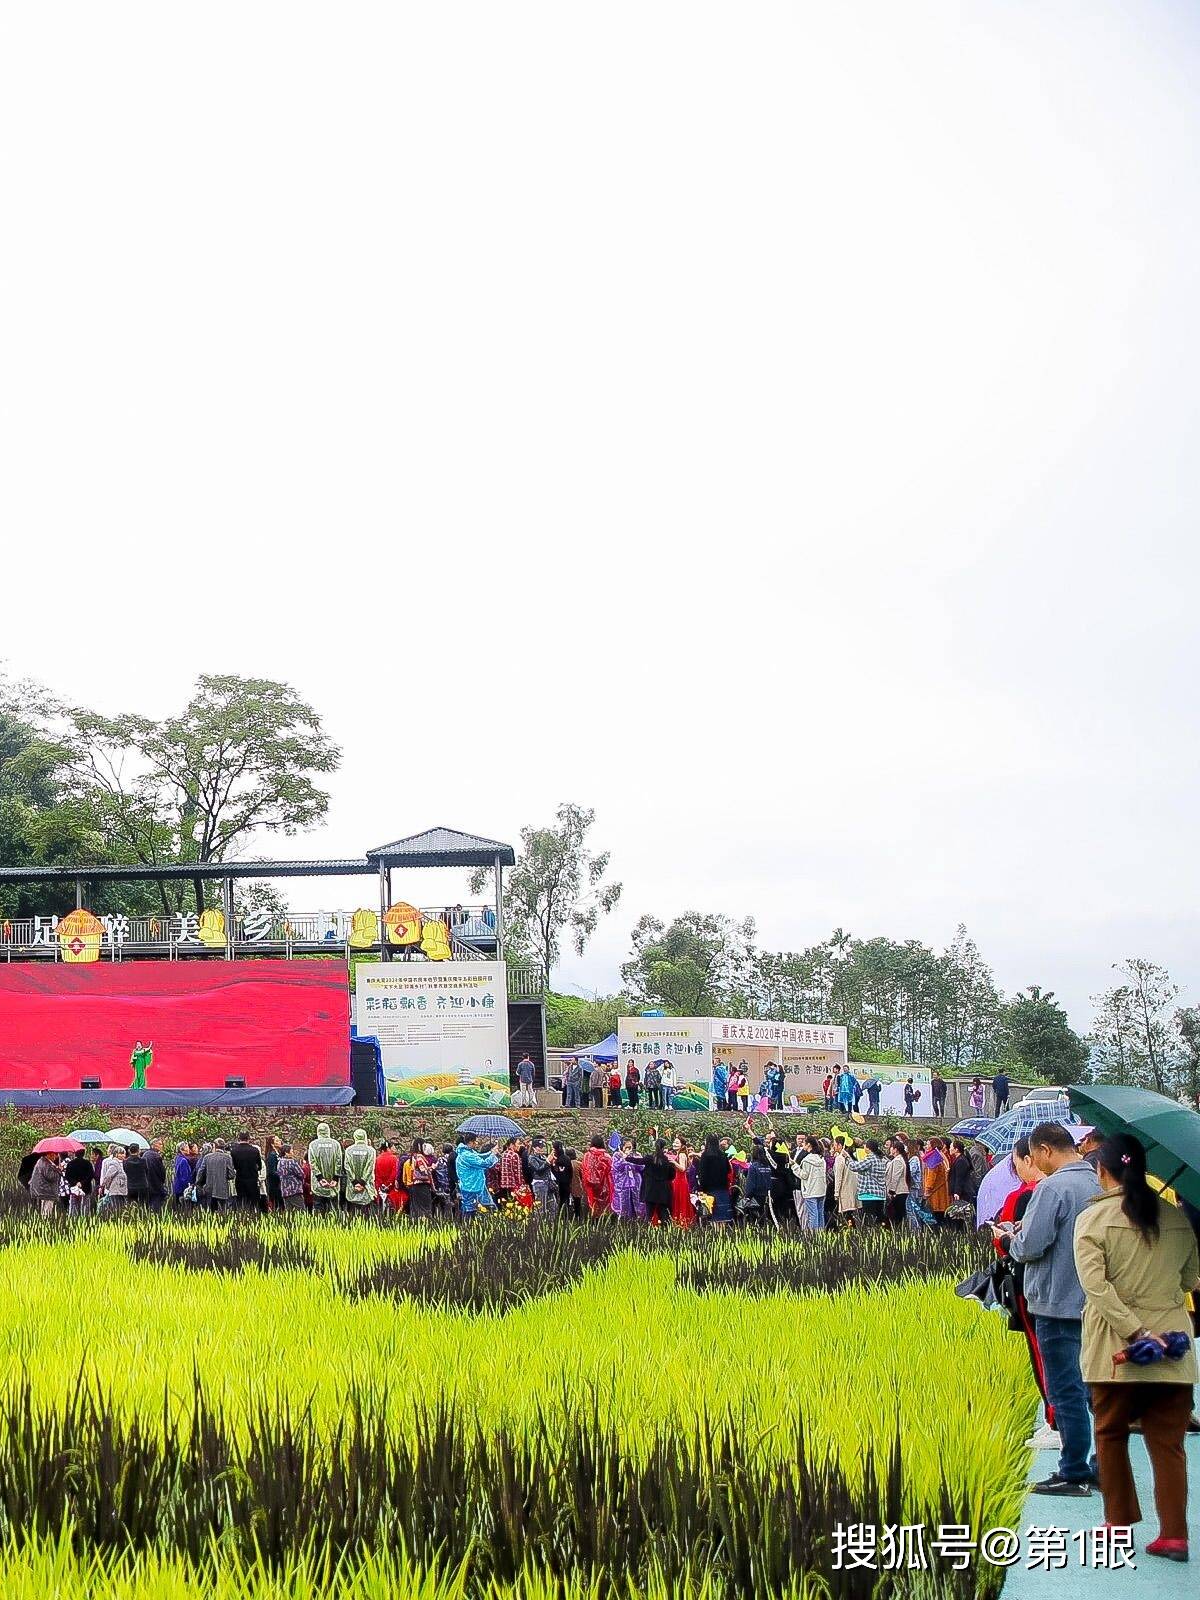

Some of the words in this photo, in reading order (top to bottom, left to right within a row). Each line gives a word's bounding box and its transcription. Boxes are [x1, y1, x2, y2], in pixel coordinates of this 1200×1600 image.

[436, 993, 495, 1010] 齐迎小康
[721, 1024, 835, 1045] 重庆大足2020年中国农民丰收节
[665, 1040, 704, 1056] 齐迎小康
[805, 1064, 832, 1075] 齐迎小
